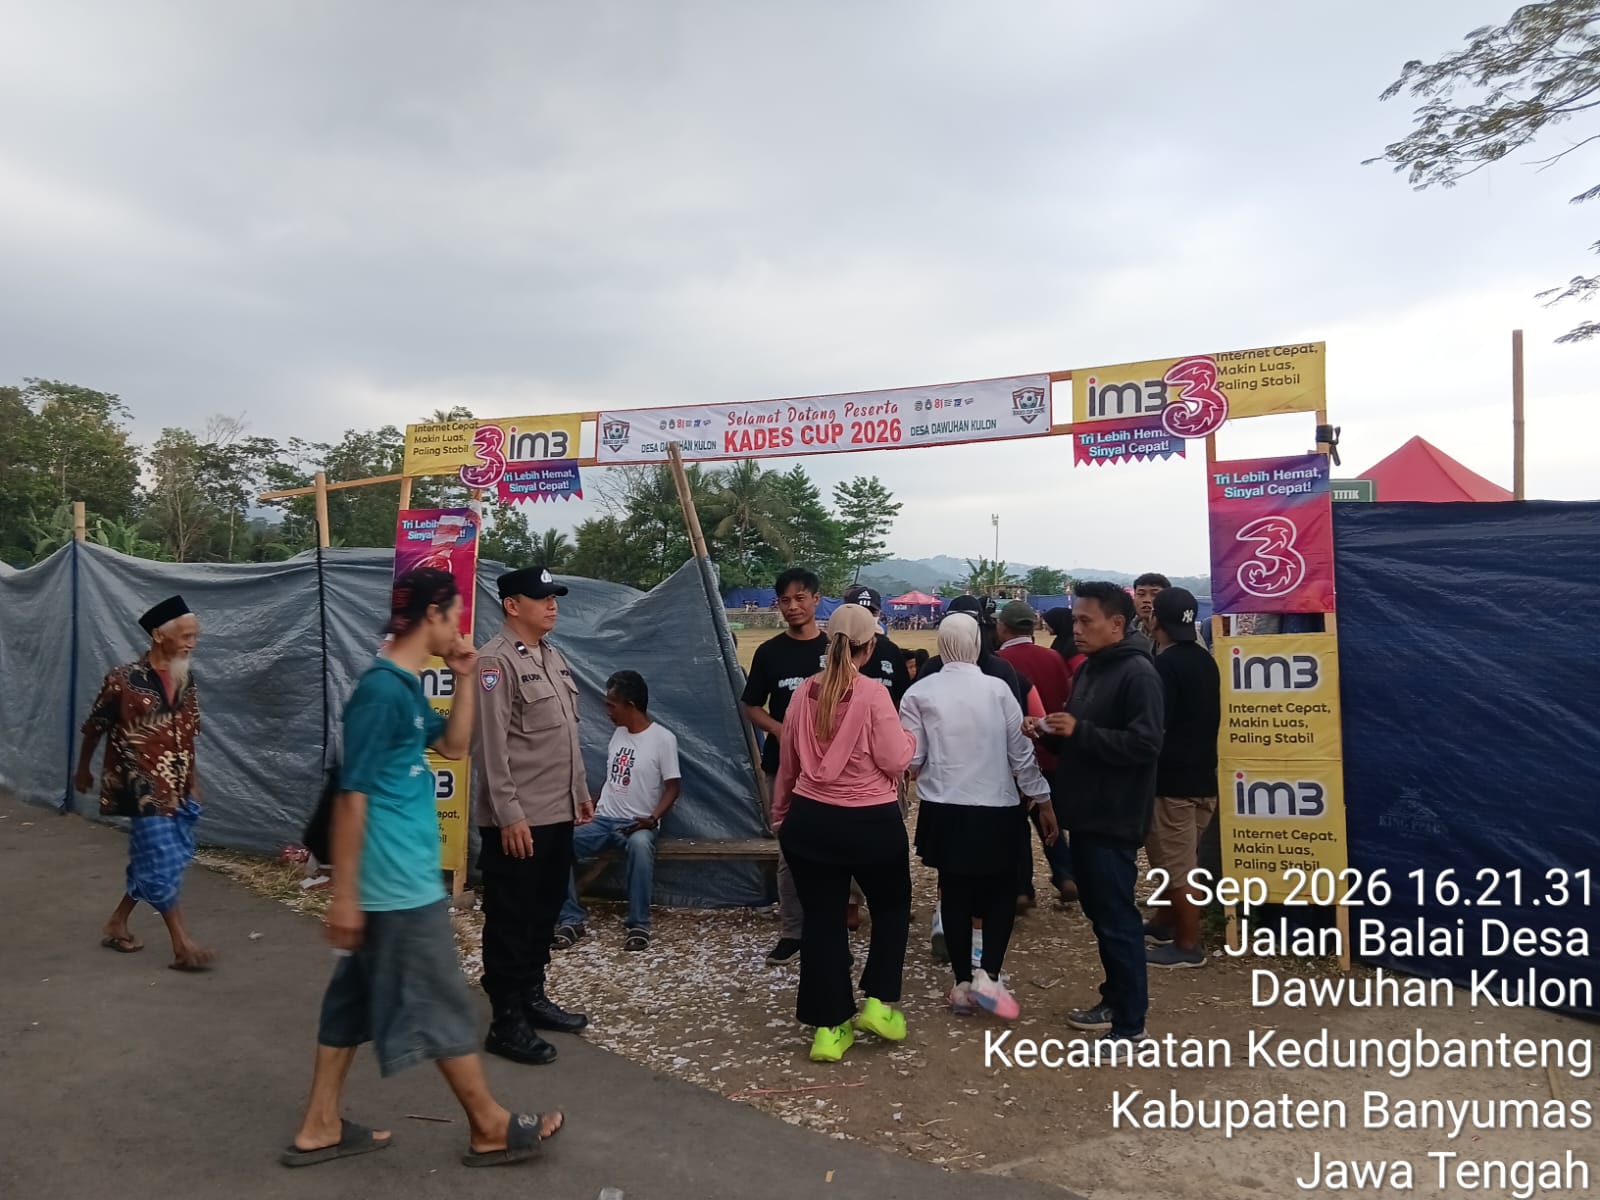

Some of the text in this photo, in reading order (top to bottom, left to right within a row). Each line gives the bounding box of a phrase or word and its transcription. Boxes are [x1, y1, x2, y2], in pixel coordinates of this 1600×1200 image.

[1216, 344, 1318, 362] Internet Cepat,
[1217, 361, 1295, 376] Makin Luas,
[1217, 374, 1300, 391] Paling Stabil
[727, 409, 782, 426] Selamat
[787, 406, 836, 423] Datang
[844, 400, 899, 418] Peserta
[414, 423, 450, 432] Internet
[910, 419, 997, 437] DESA DAWUHAN KULON
[414, 435, 466, 444] Makin Luas,
[723, 418, 902, 453] KADES CUP 2026
[1079, 434, 1094, 445] Tri
[1097, 430, 1130, 443] Lebih
[413, 445, 469, 456] Paling Stabil
[641, 440, 717, 454] DESA DAHAN KULON
[1089, 440, 1170, 457] Sinyal Cepat!
[515, 471, 540, 481] Lebih
[543, 469, 575, 480] Hemat,
[1213, 467, 1322, 485] Tri Lebih Hemat,
[509, 481, 570, 494] Sinyal Cepat!
[1224, 482, 1312, 499] Sinyal Cepat!
[402, 520, 413, 529] Tri
[408, 530, 434, 541] Sinyal
[1236, 516, 1306, 598] 3
[1228, 702, 1332, 716] Internet Cepat,
[1229, 717, 1309, 729] Makin Luas,
[1230, 732, 1315, 746] Paling Stabil
[437, 810, 460, 820] epat,
[1233, 828, 1337, 843] Internet Cepat,
[1233, 843, 1315, 857] Makin Luas,
[1234, 859, 1320, 873] Paling Stabil
